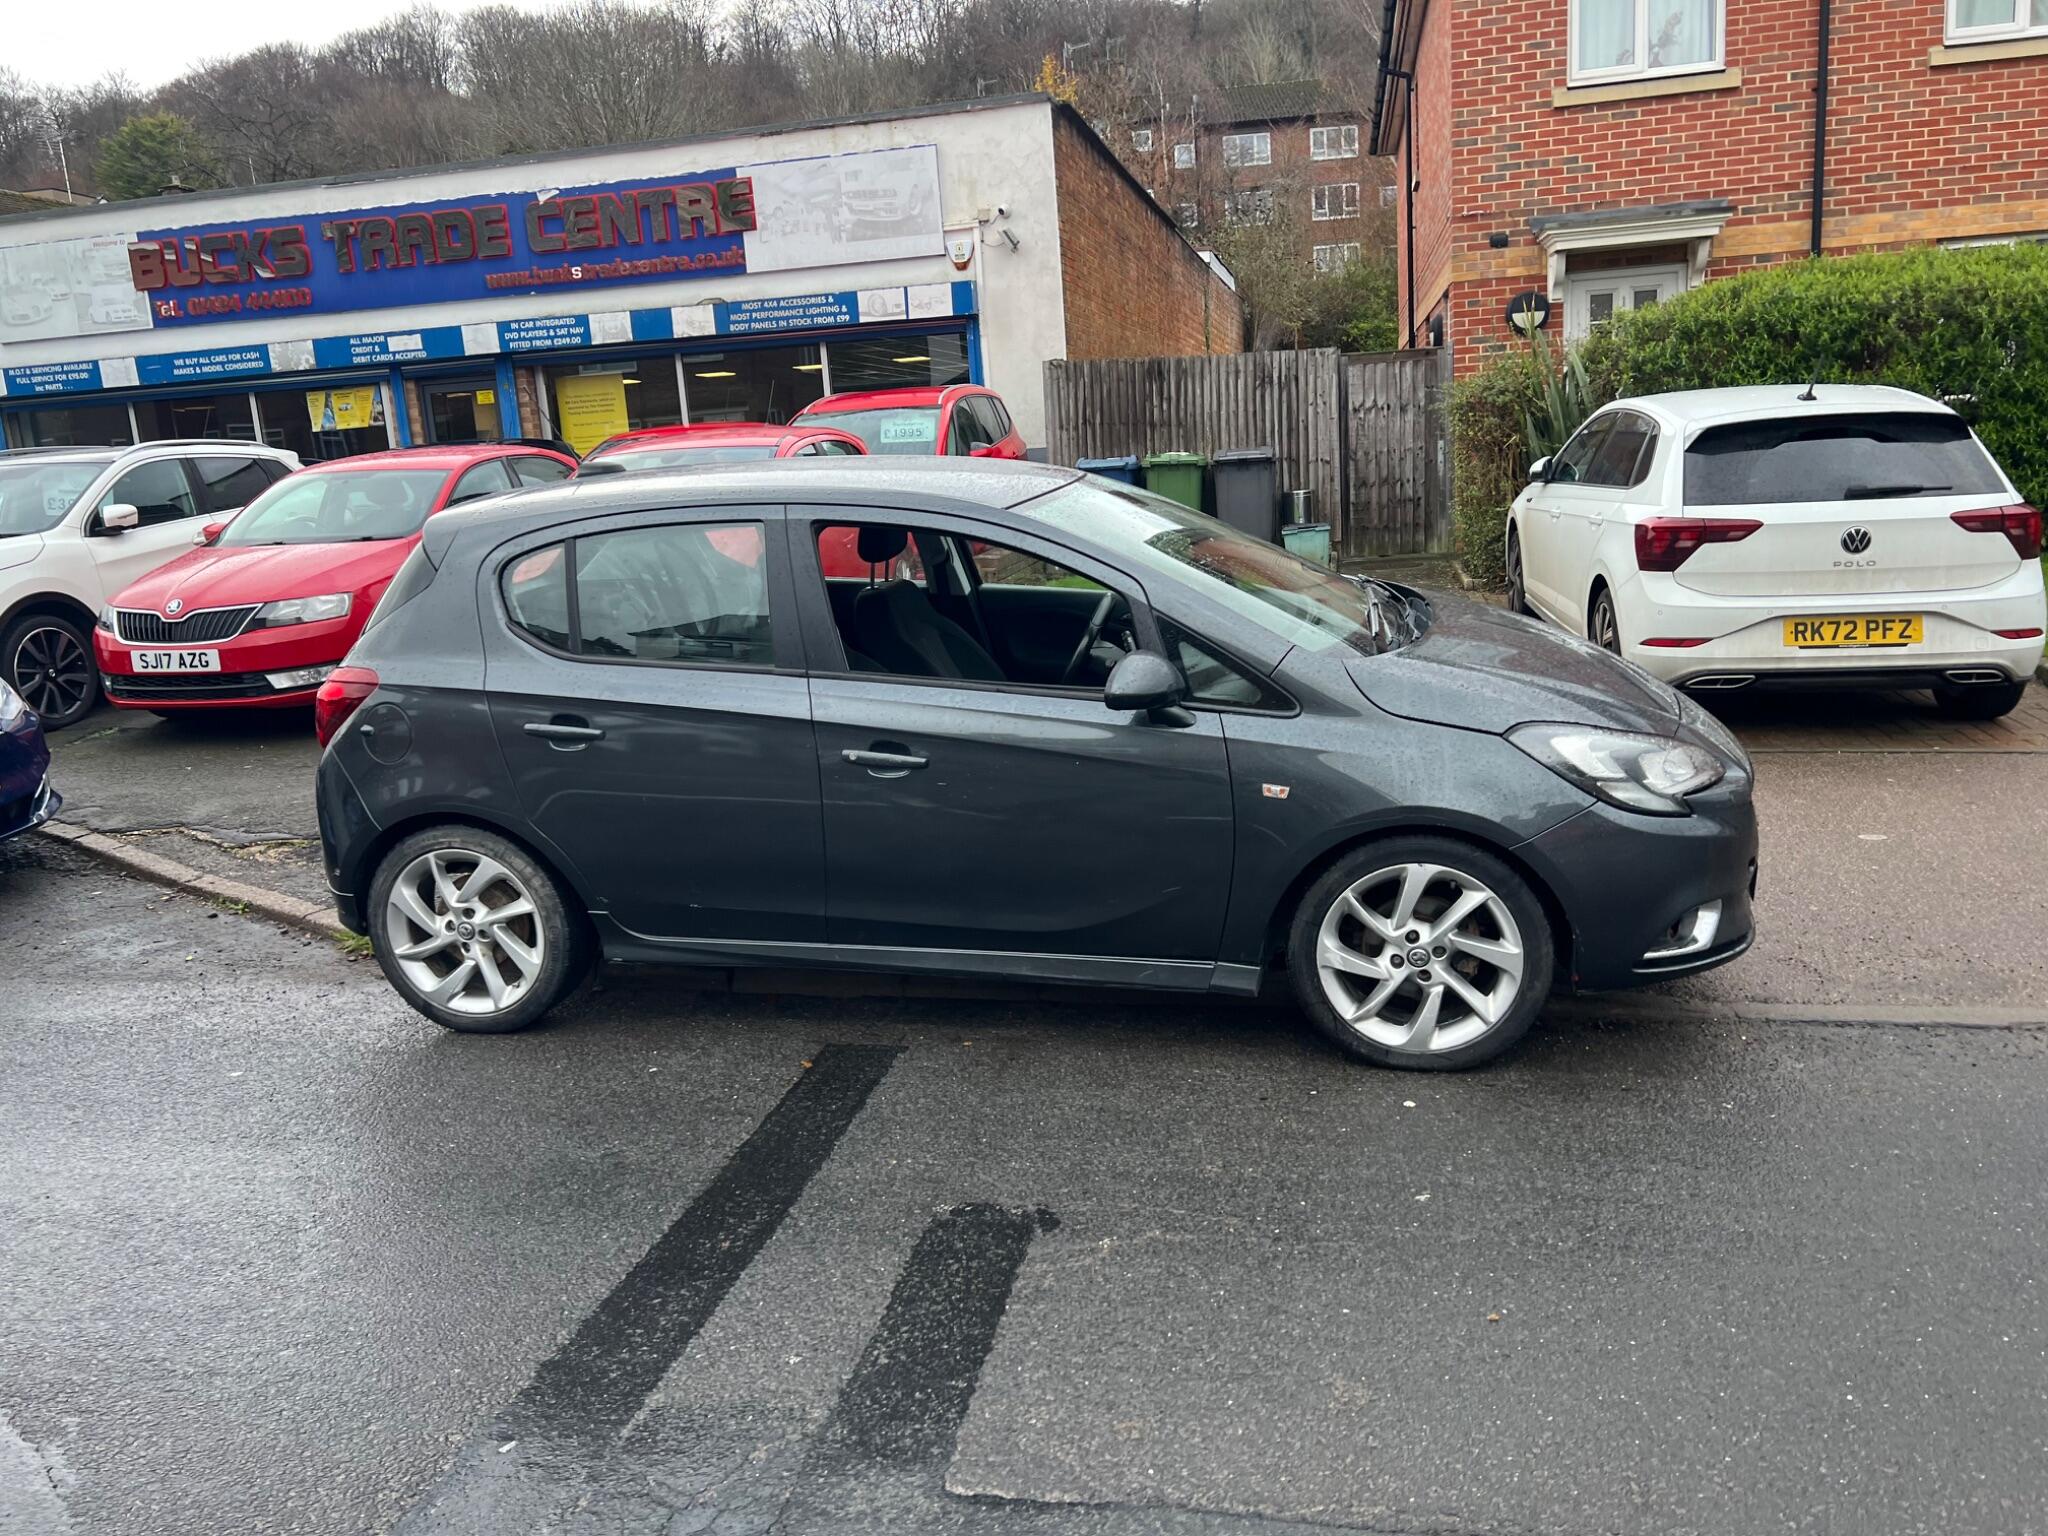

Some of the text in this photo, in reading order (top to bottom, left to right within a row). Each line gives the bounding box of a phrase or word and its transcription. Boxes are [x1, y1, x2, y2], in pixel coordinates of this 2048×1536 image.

[128, 174, 757, 292] BUCKS TRADE CENTRE
[780, 296, 825, 306] ACCESSORIES
[752, 308, 804, 319] PERFORMANCE
[806, 305, 839, 314] LIGHTING
[535, 318, 575, 327] INTEGRATED
[751, 321, 776, 329] PANELS
[789, 318, 812, 326] STOCK
[814, 316, 834, 324] FROM
[521, 330, 547, 338] PLAYERS
[351, 346, 372, 354] CREDIT
[510, 341, 531, 349] FITTED
[372, 353, 393, 362] CARDS
[395, 351, 427, 360] ACCEPTED
[32, 365, 62, 374] SERVICING
[63, 362, 94, 371] AVAILABLE
[174, 367, 194, 375] MAKES
[225, 361, 264, 370] CONSIDERED
[1794, 619, 1912, 641] RK72 PFZ
[140, 652, 209, 669] SJ17 AZG
